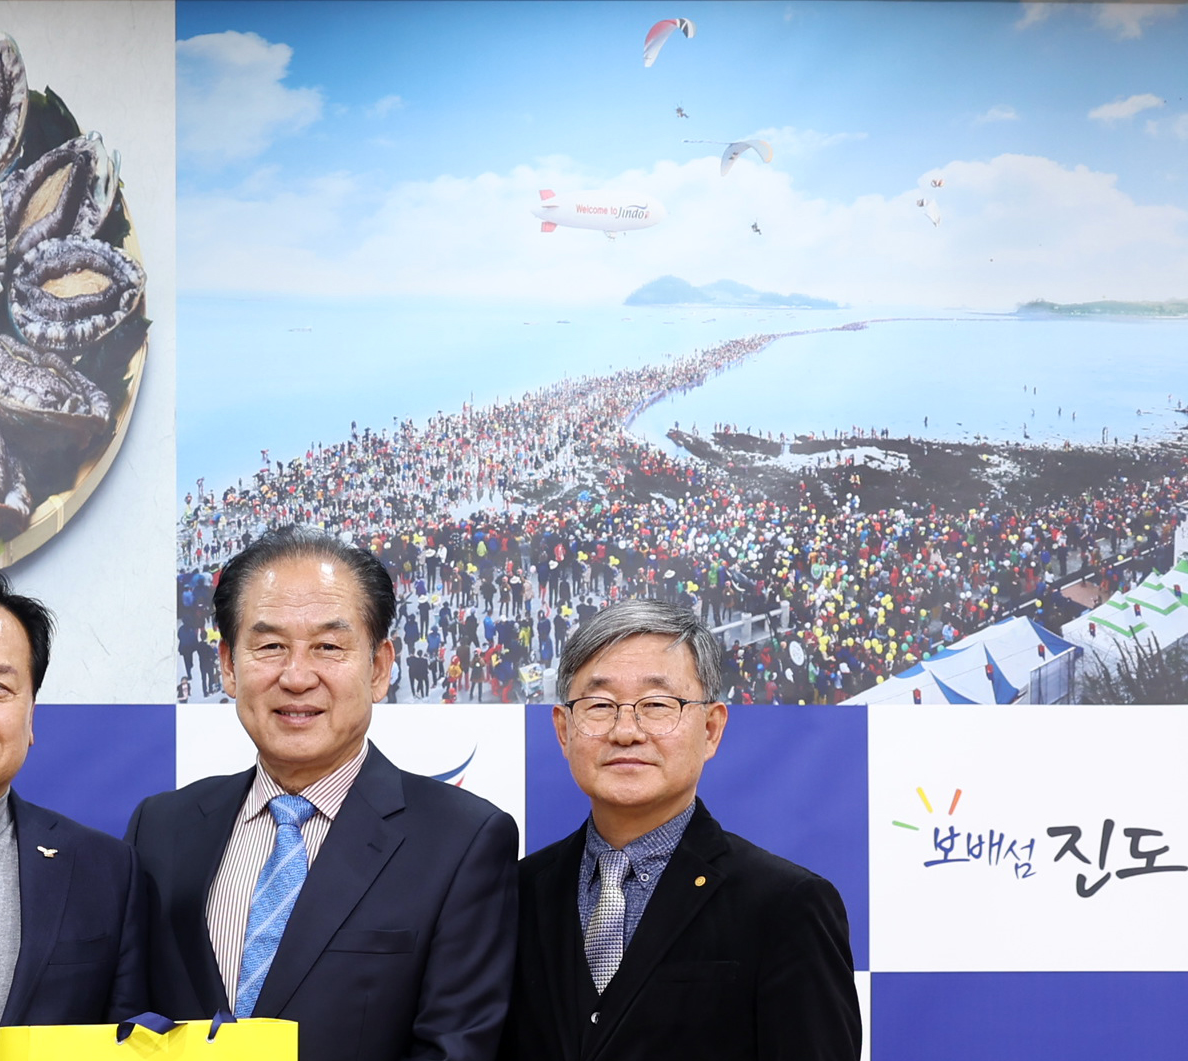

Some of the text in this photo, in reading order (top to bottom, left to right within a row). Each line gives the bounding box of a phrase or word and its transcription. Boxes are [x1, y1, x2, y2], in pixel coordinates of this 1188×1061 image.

[576, 204, 608, 215] Welcome
[610, 206, 618, 216] to
[924, 818, 1188, 898] 보배섬 진도
